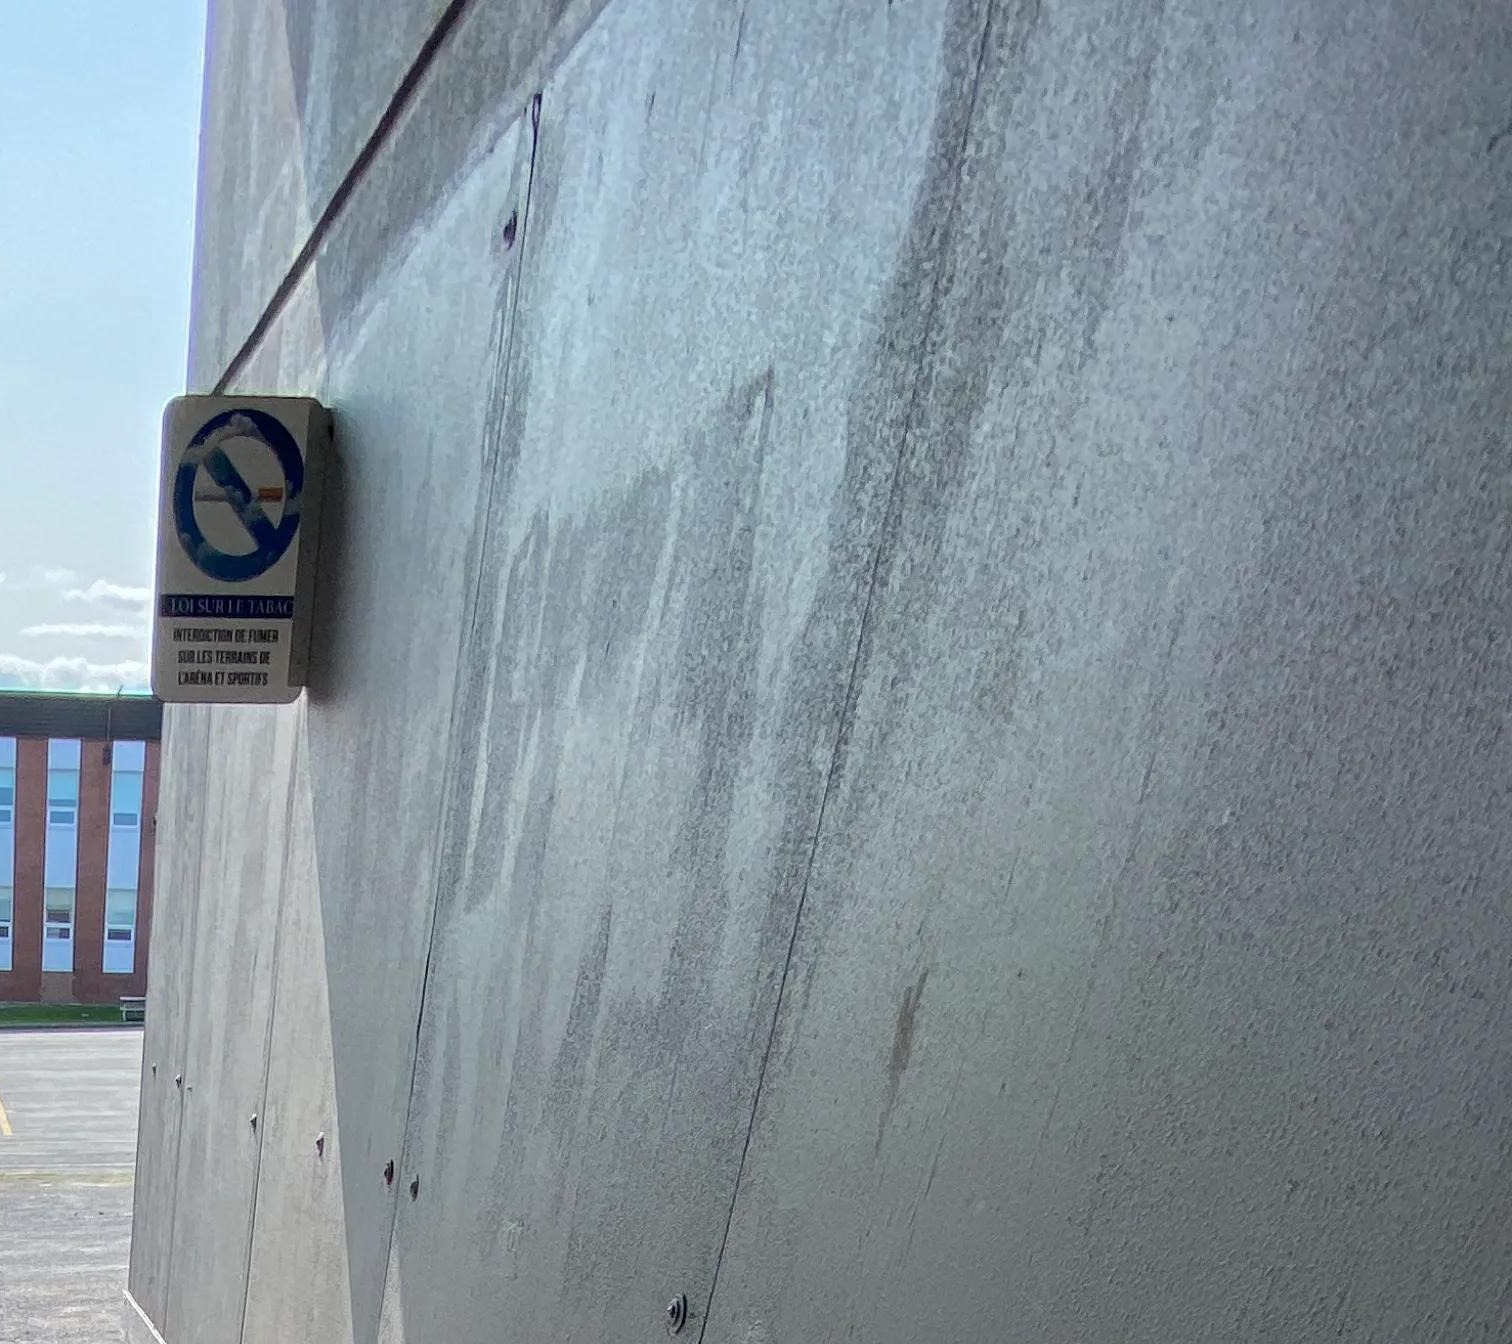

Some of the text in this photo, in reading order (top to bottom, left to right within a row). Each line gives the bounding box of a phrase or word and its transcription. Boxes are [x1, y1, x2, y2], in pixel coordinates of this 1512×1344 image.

[170, 598, 293, 615] LOI SUR LE TABAC
[173, 628, 279, 644] INTERDICTION DE FUMER
[178, 650, 271, 665] SUR LES TERRAINS DE
[214, 672, 226, 686] ET
[227, 672, 268, 686] SPORTIFS
